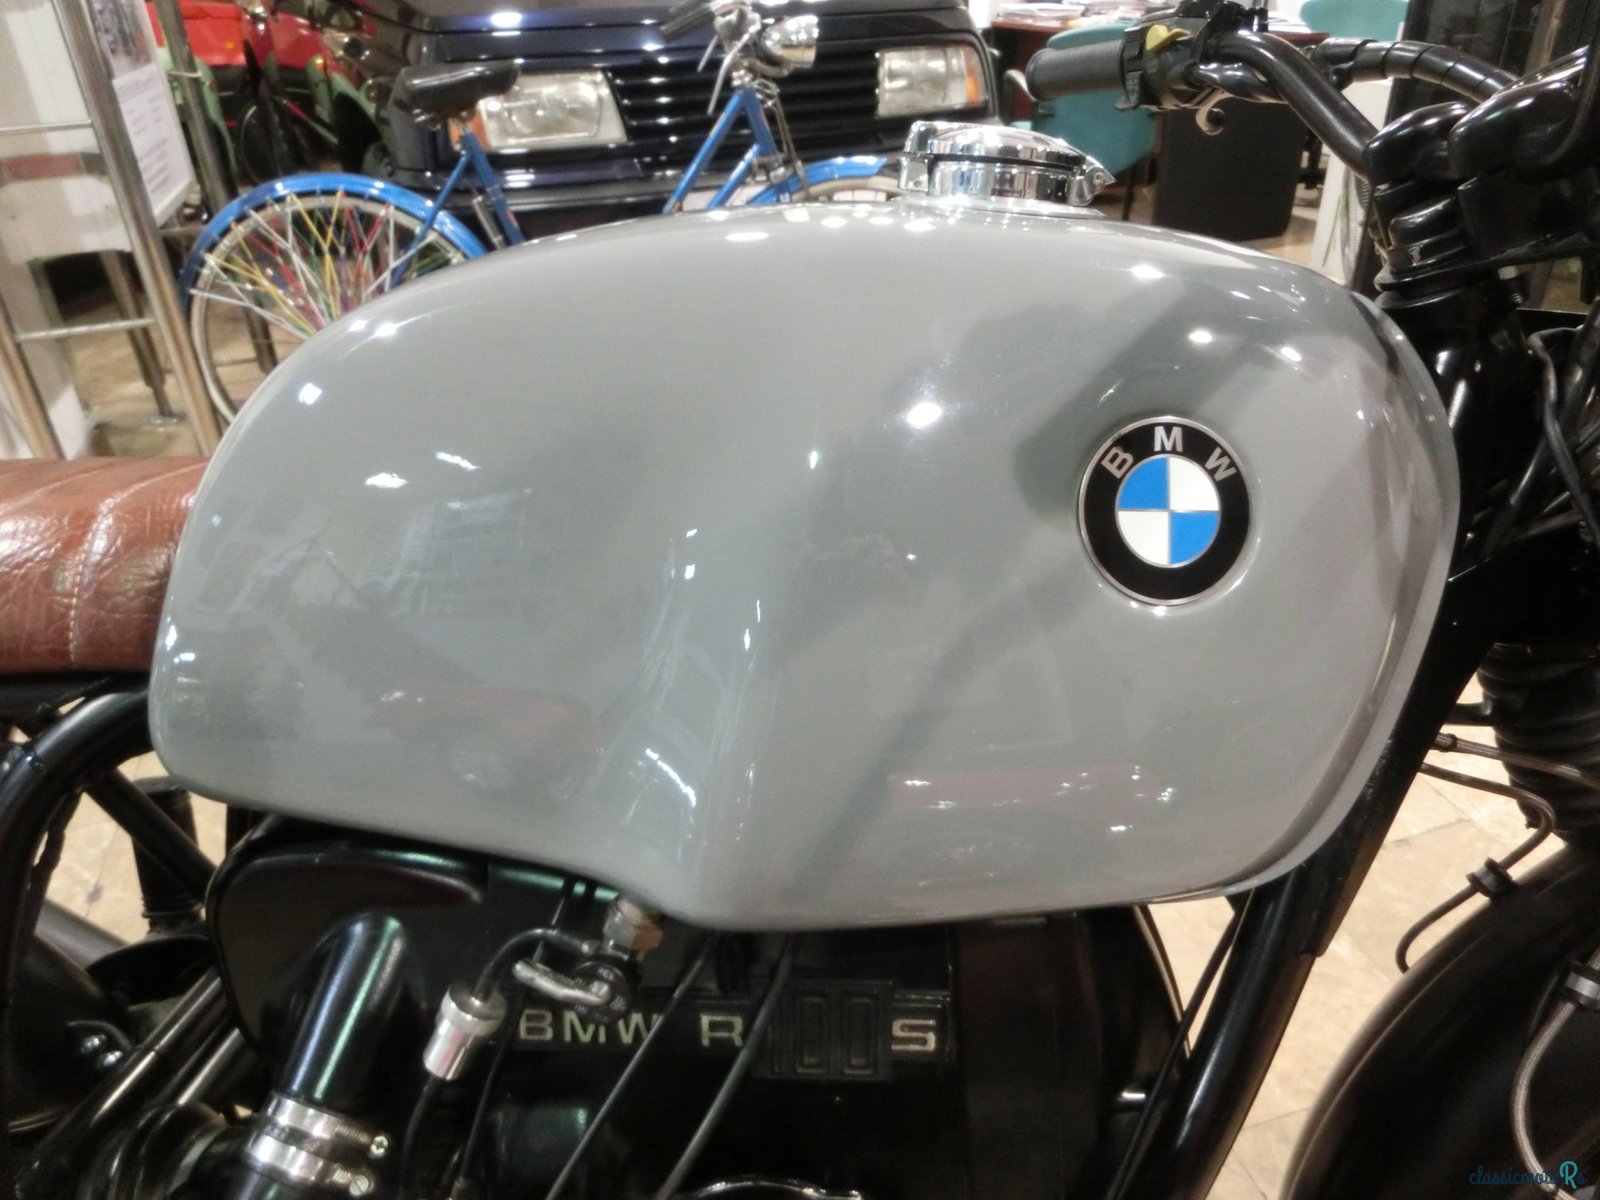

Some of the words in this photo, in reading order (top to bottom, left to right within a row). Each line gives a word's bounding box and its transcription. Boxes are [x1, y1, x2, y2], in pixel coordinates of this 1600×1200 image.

[1101, 426, 1237, 482] BMW
[519, 1009, 660, 1045] BMW
[701, 1013, 745, 1047] R
[890, 1018, 937, 1052] S
